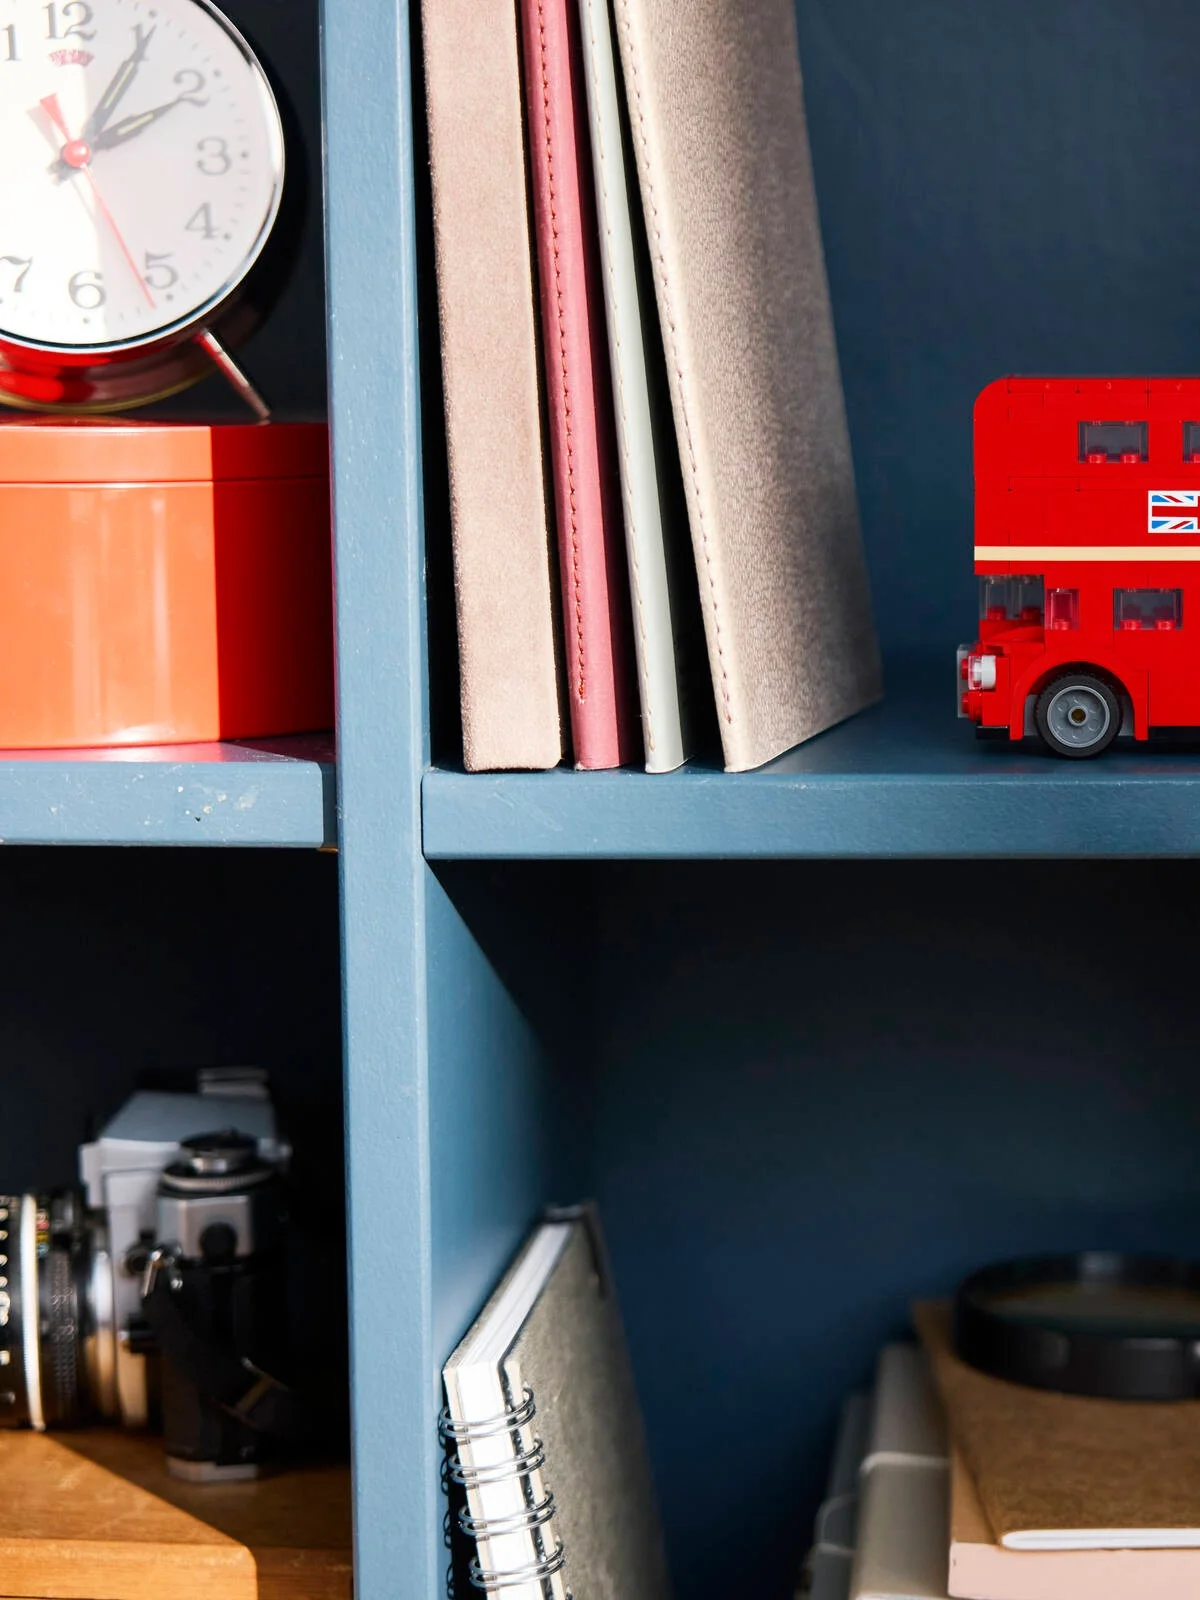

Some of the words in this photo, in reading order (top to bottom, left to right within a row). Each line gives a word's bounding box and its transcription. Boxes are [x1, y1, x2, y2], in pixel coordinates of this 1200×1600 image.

[42, 1, 98, 41] 12
[2, 24, 22, 61] 1
[172, 68, 211, 108] 2
[195, 135, 234, 177] 3
[184, 201, 222, 241] 4
[0, 254, 34, 294] 7
[68, 270, 108, 310] 6
[143, 250, 180, 290] 5
